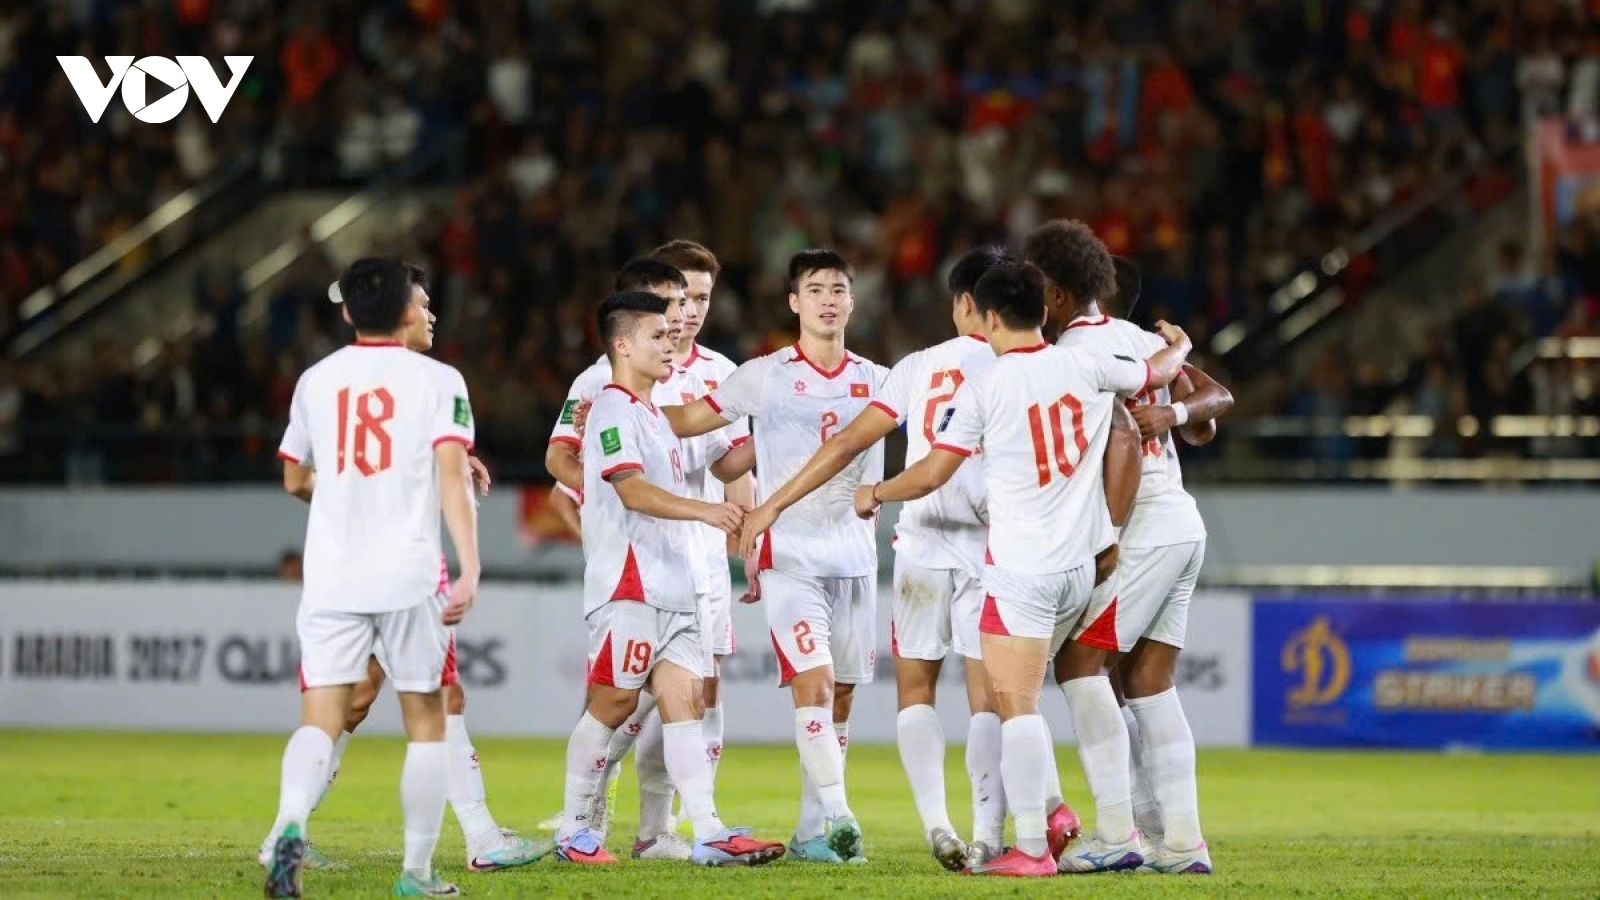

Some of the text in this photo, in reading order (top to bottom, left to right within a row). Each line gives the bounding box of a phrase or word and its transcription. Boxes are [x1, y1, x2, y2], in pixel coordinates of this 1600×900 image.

[336, 386, 395, 477] 18
[821, 411, 838, 446] 2
[1027, 392, 1088, 488] 10
[792, 620, 816, 655] 2
[622, 639, 652, 675] 19
